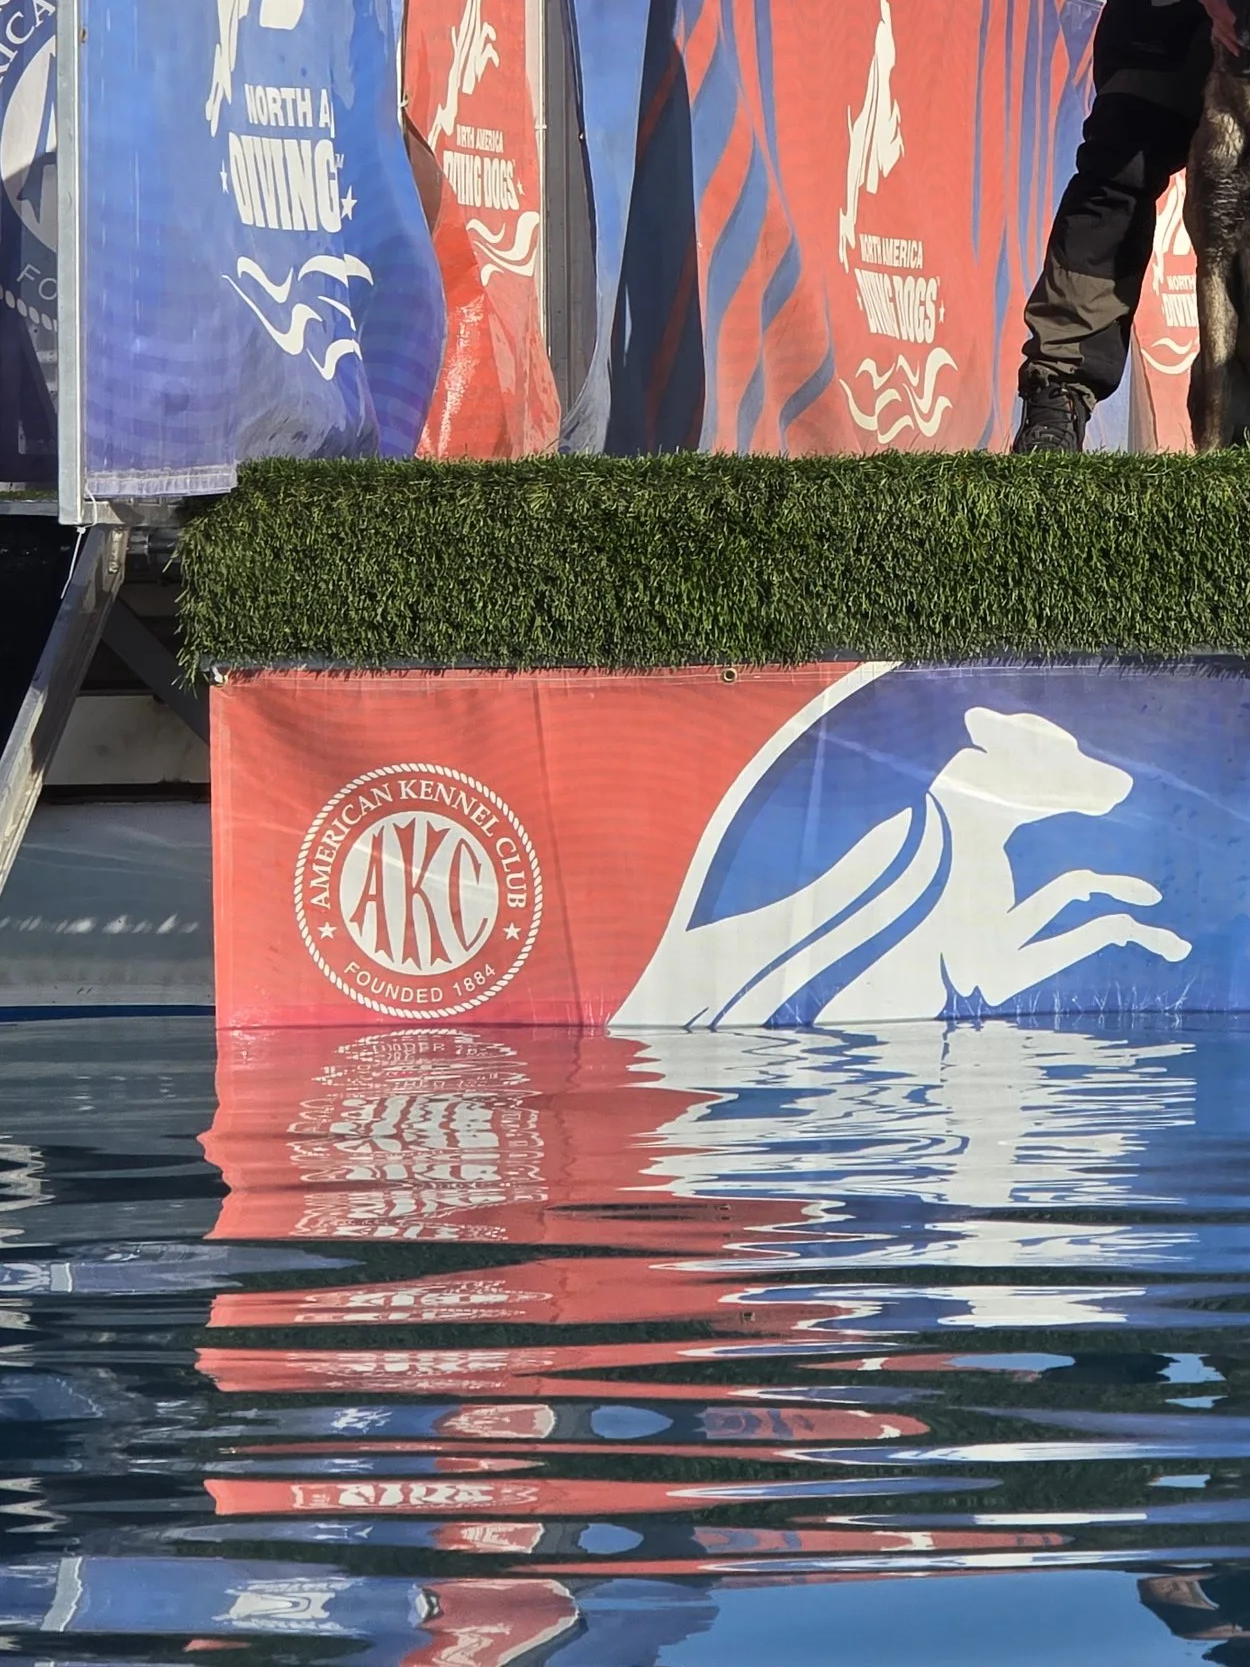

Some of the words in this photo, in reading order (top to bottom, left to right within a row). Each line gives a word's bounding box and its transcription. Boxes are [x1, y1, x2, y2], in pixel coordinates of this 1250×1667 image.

[245, 83, 313, 127] NORTH
[228, 131, 342, 233] DIVING
[483, 157, 520, 210] DOGS
[882, 237, 924, 269] AMERICA
[892, 275, 938, 343] DOGS
[310, 782, 393, 909] AMERICAN
[397, 779, 500, 837] KENNEL
[495, 837, 527, 909] CLUB
[349, 817, 488, 971] AKC
[344, 961, 443, 1003] FOUNDED
[452, 964, 496, 997] 1884
